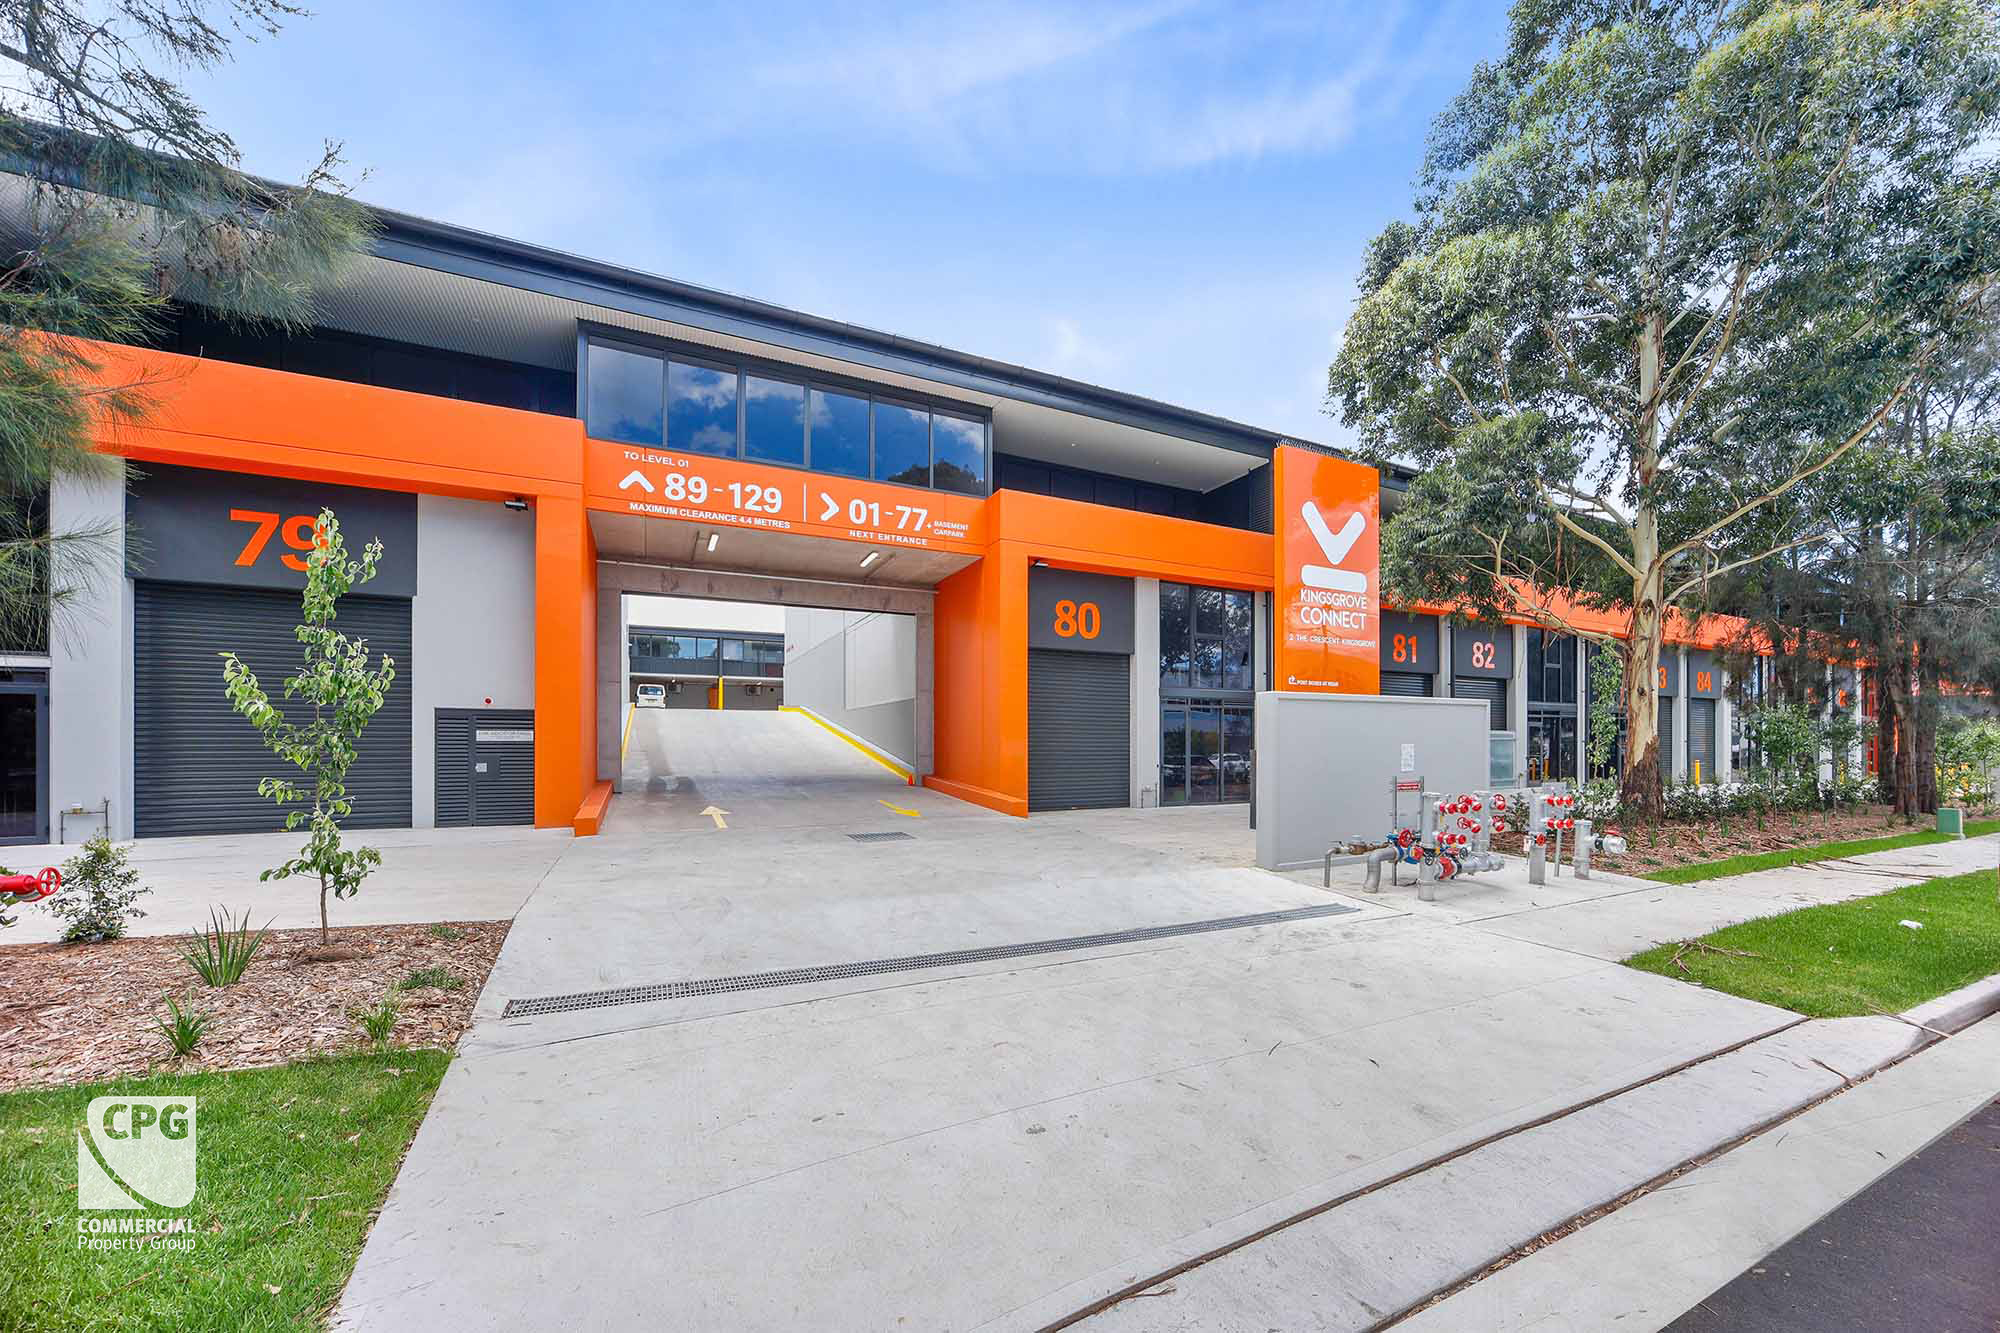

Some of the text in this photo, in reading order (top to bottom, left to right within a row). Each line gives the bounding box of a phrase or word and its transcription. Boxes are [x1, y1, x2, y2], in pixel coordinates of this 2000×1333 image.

[624, 450, 689, 468] TO LEVEL 01
[629, 502, 678, 516] MAXIMUM
[680, 508, 737, 523] CLEARANCE
[753, 517, 791, 529] METRES
[934, 520, 969, 531] BASEMENT
[230, 508, 329, 572] 79
[848, 529, 928, 545] NEXT ENTRANCE
[1300, 589, 1367, 609] KINGSGROVE
[1055, 600, 1101, 640] 80
[1300, 606, 1367, 631] CONNECT
[1392, 633, 1418, 664] 81
[1472, 641, 1496, 669] 82
[1696, 671, 1713, 693] 84
